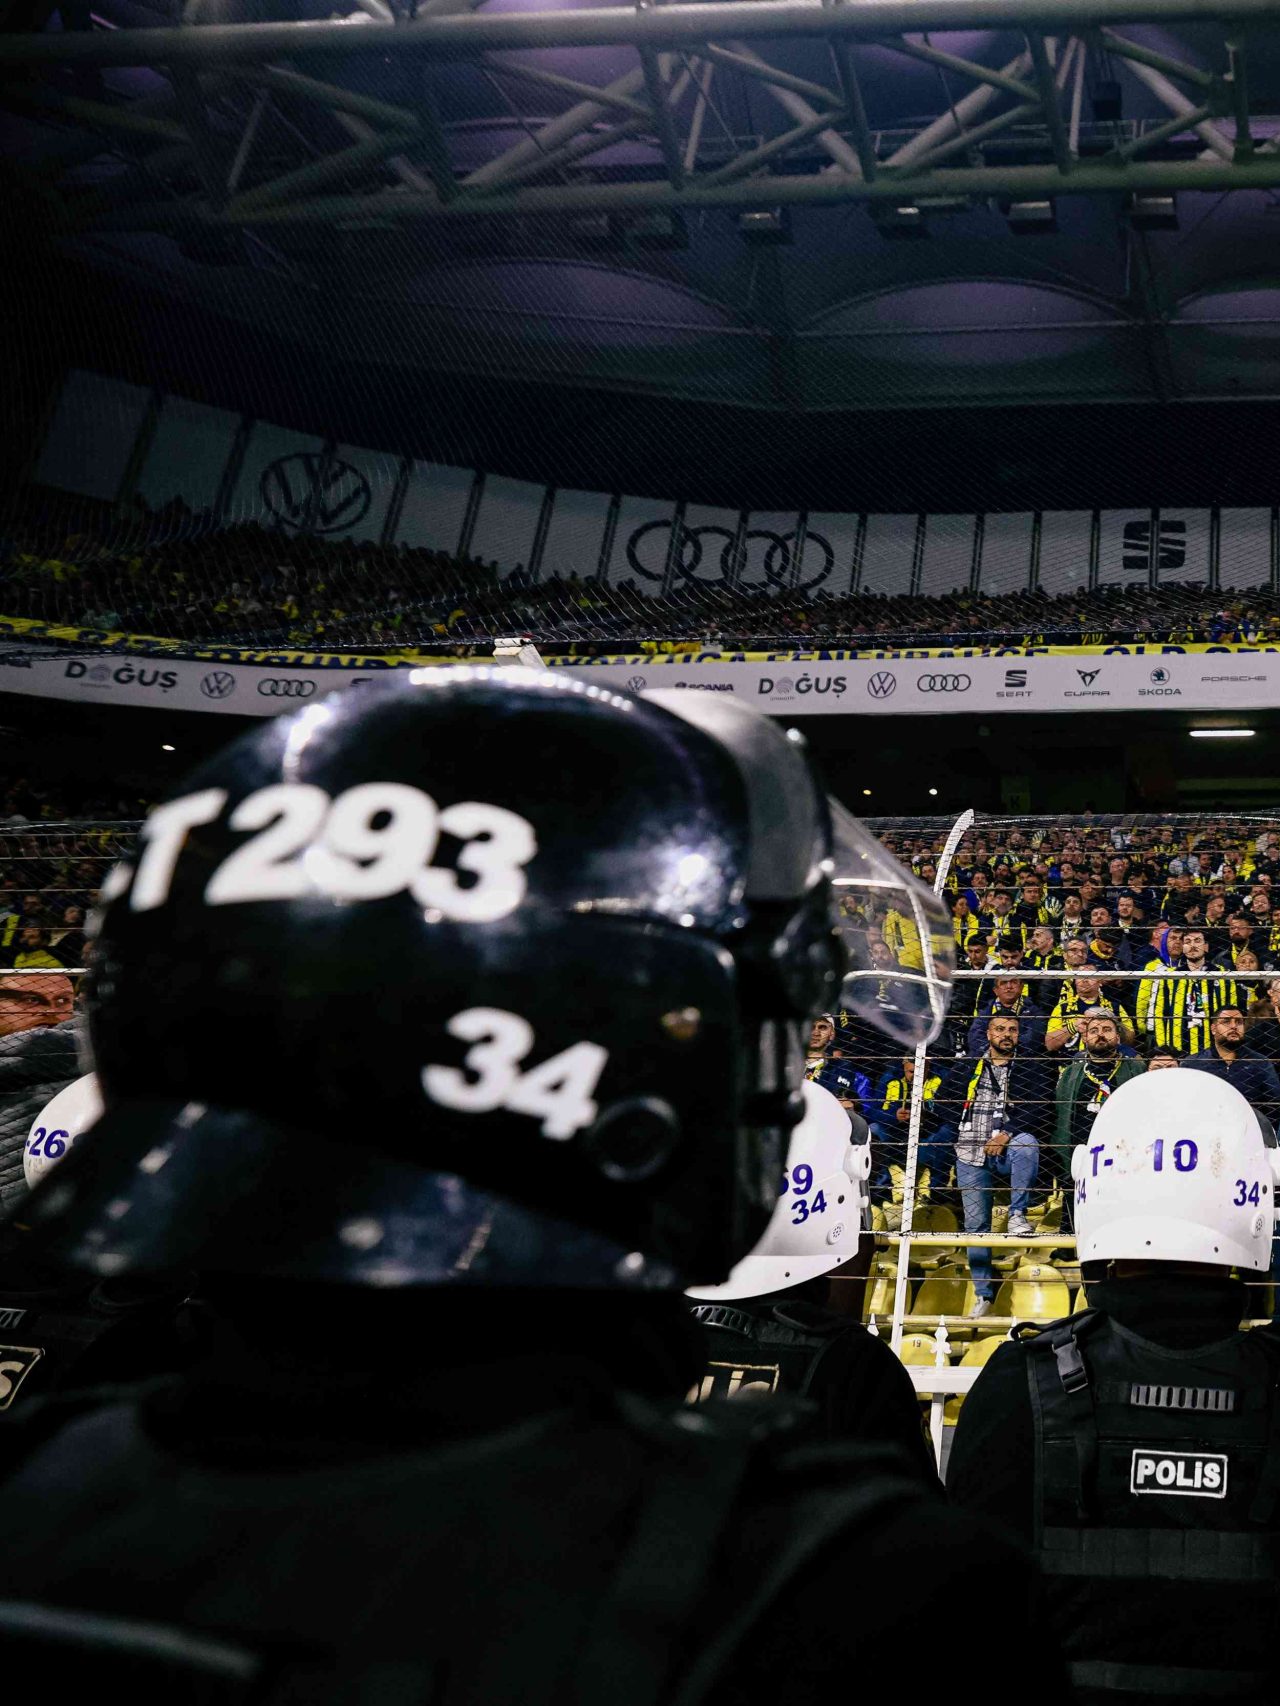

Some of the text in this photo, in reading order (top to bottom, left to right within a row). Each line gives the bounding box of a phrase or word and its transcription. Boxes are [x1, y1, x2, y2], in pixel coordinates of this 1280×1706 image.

[421, 1006, 609, 1141] 34
[791, 1189, 828, 1225] 34
[1233, 1179, 1260, 1207] 34
[1136, 1458, 1222, 1489] POLİS
